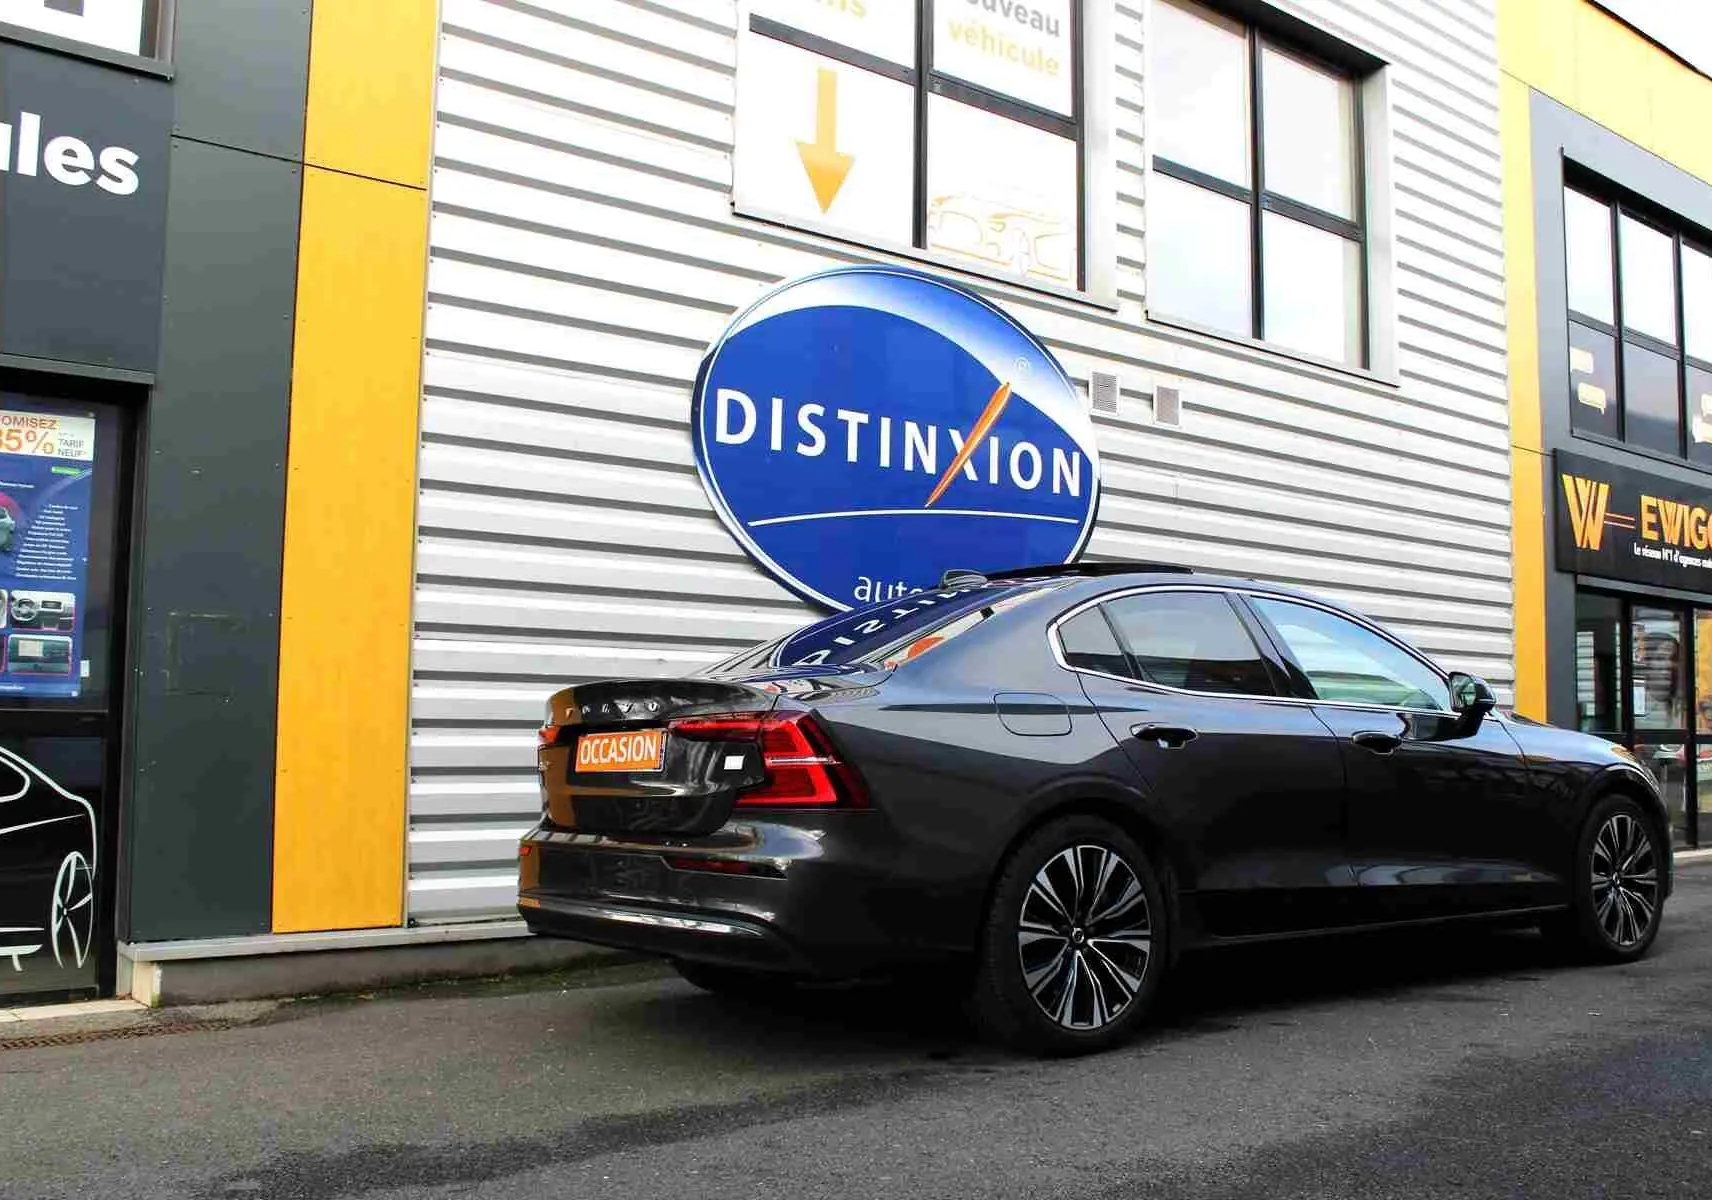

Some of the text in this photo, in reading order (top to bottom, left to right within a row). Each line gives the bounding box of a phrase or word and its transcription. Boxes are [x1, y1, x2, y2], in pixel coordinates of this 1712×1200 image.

[966, 0, 1060, 37] uveau
[948, 20, 1060, 75] véhicule
[0, 428, 54, 455] 5%
[715, 382, 1081, 507] DISTINXION
[580, 735, 658, 765] OCCASION
